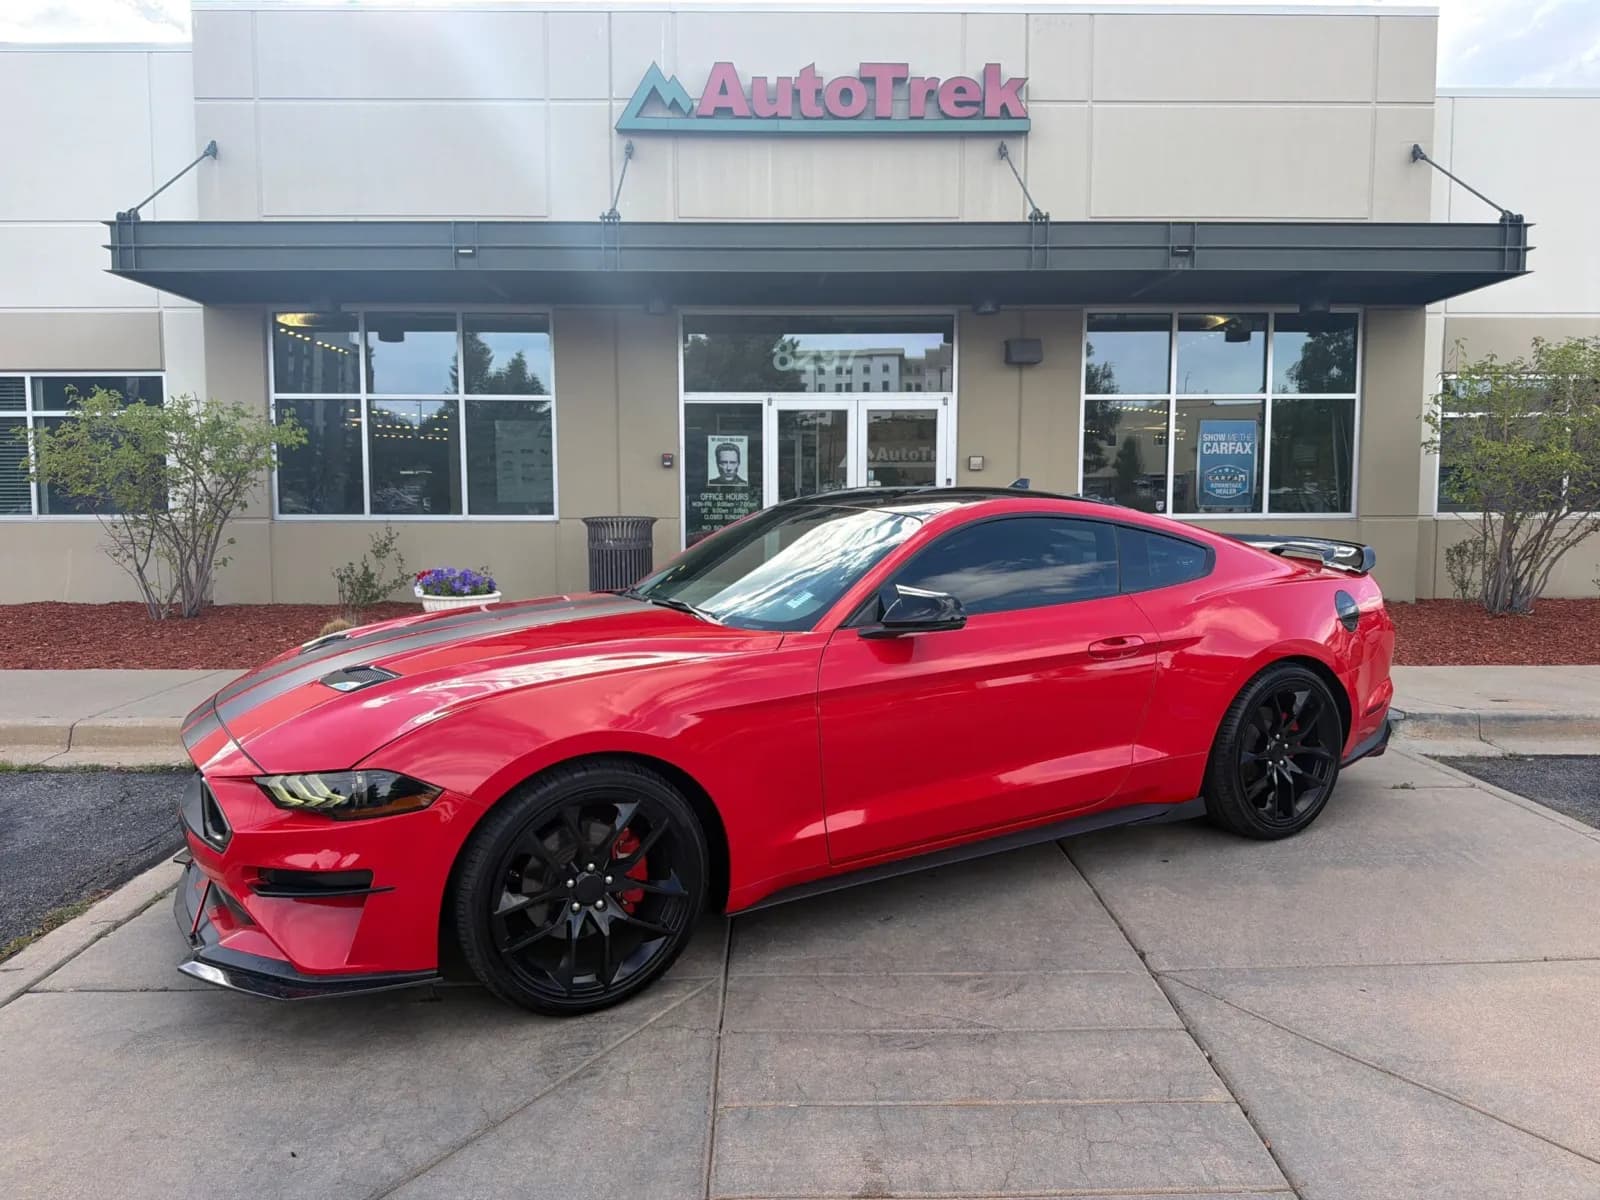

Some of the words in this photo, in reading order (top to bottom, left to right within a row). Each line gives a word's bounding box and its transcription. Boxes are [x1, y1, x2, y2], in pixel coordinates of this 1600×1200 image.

[695, 61, 1028, 119] AutoTrek
[1202, 432, 1226, 442] SHOW
[876, 446, 936, 461] AutoTr
[1202, 442, 1252, 455] CARFAX
[699, 493, 724, 501] OFFICE
[725, 493, 749, 501] HOURS
